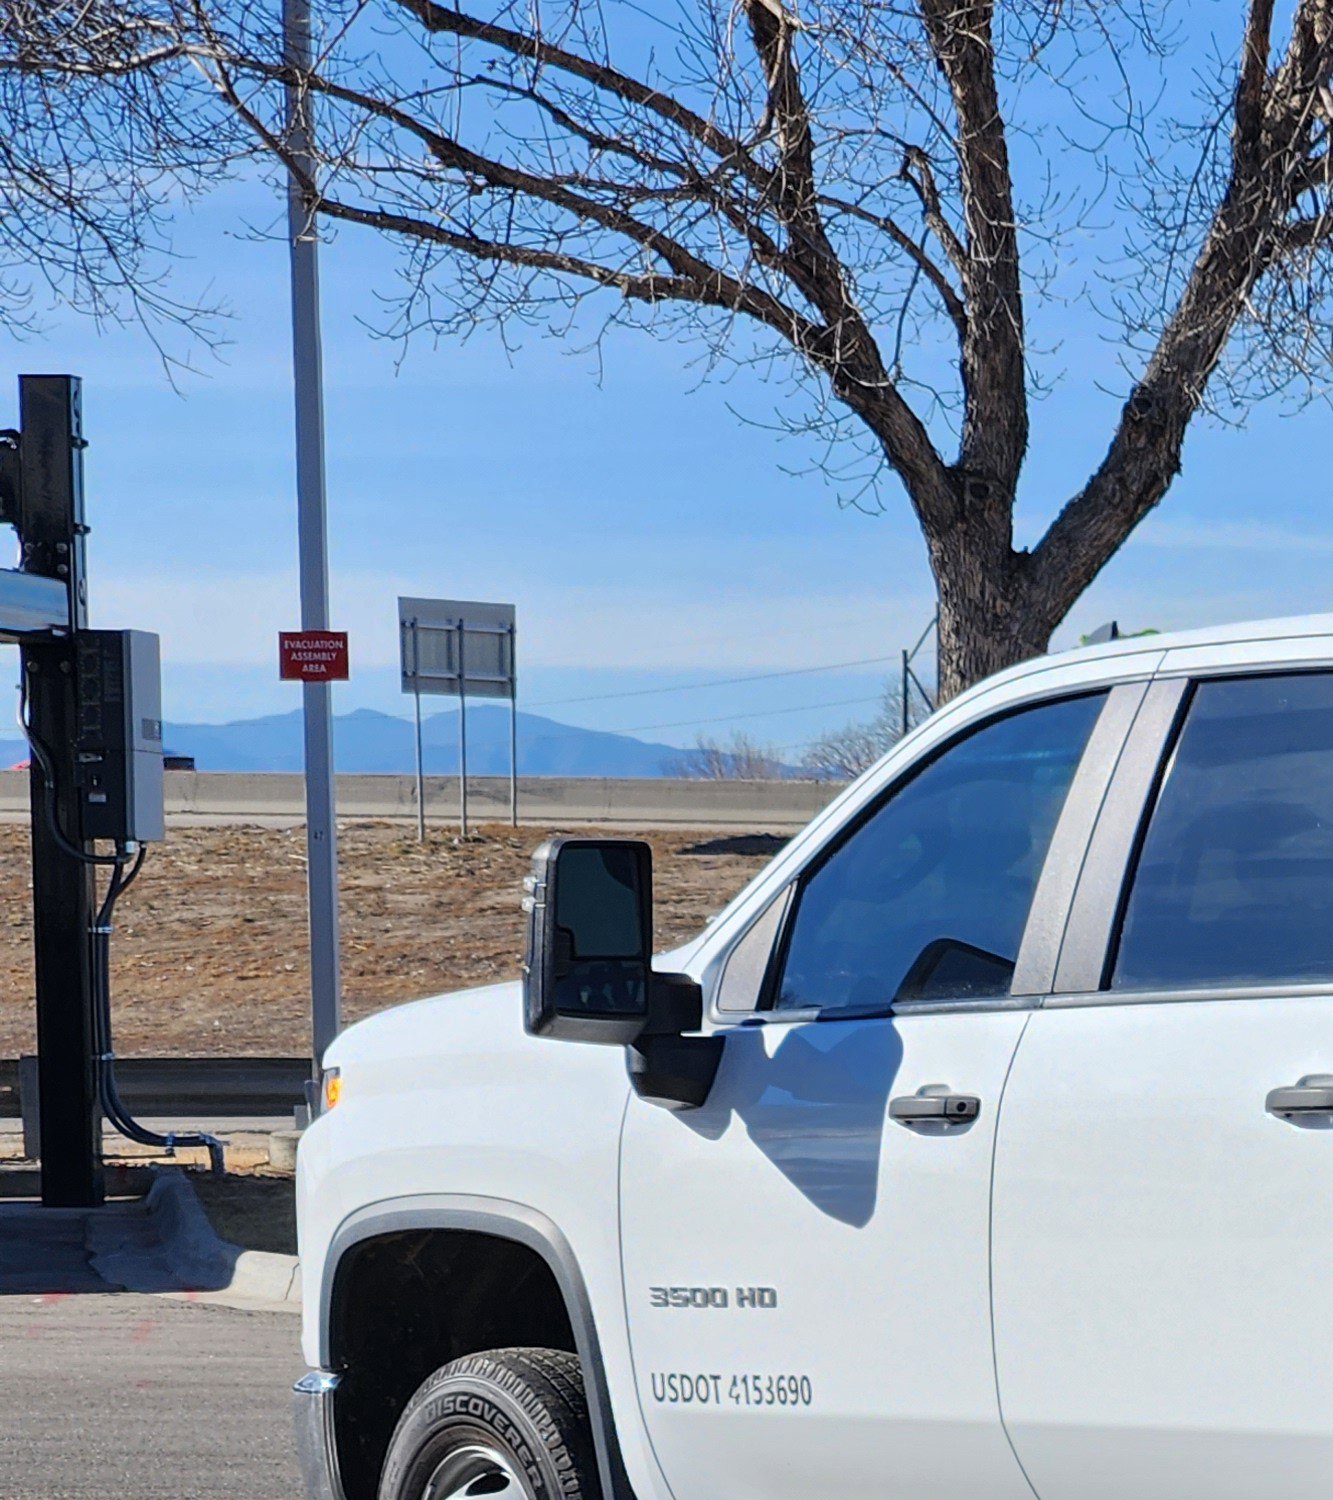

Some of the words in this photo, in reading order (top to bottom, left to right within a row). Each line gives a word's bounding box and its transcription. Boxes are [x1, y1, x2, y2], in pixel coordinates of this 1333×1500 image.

[283, 640, 344, 650] EVACUATION
[290, 652, 338, 661] ASSEMBLY
[302, 664, 327, 673] AREA
[649, 1286, 729, 1308] 3500
[736, 1286, 778, 1308] HD
[650, 1372, 722, 1404] USDOT
[728, 1374, 813, 1406] 4153690
[424, 1395, 543, 1490] DISCOVERER
